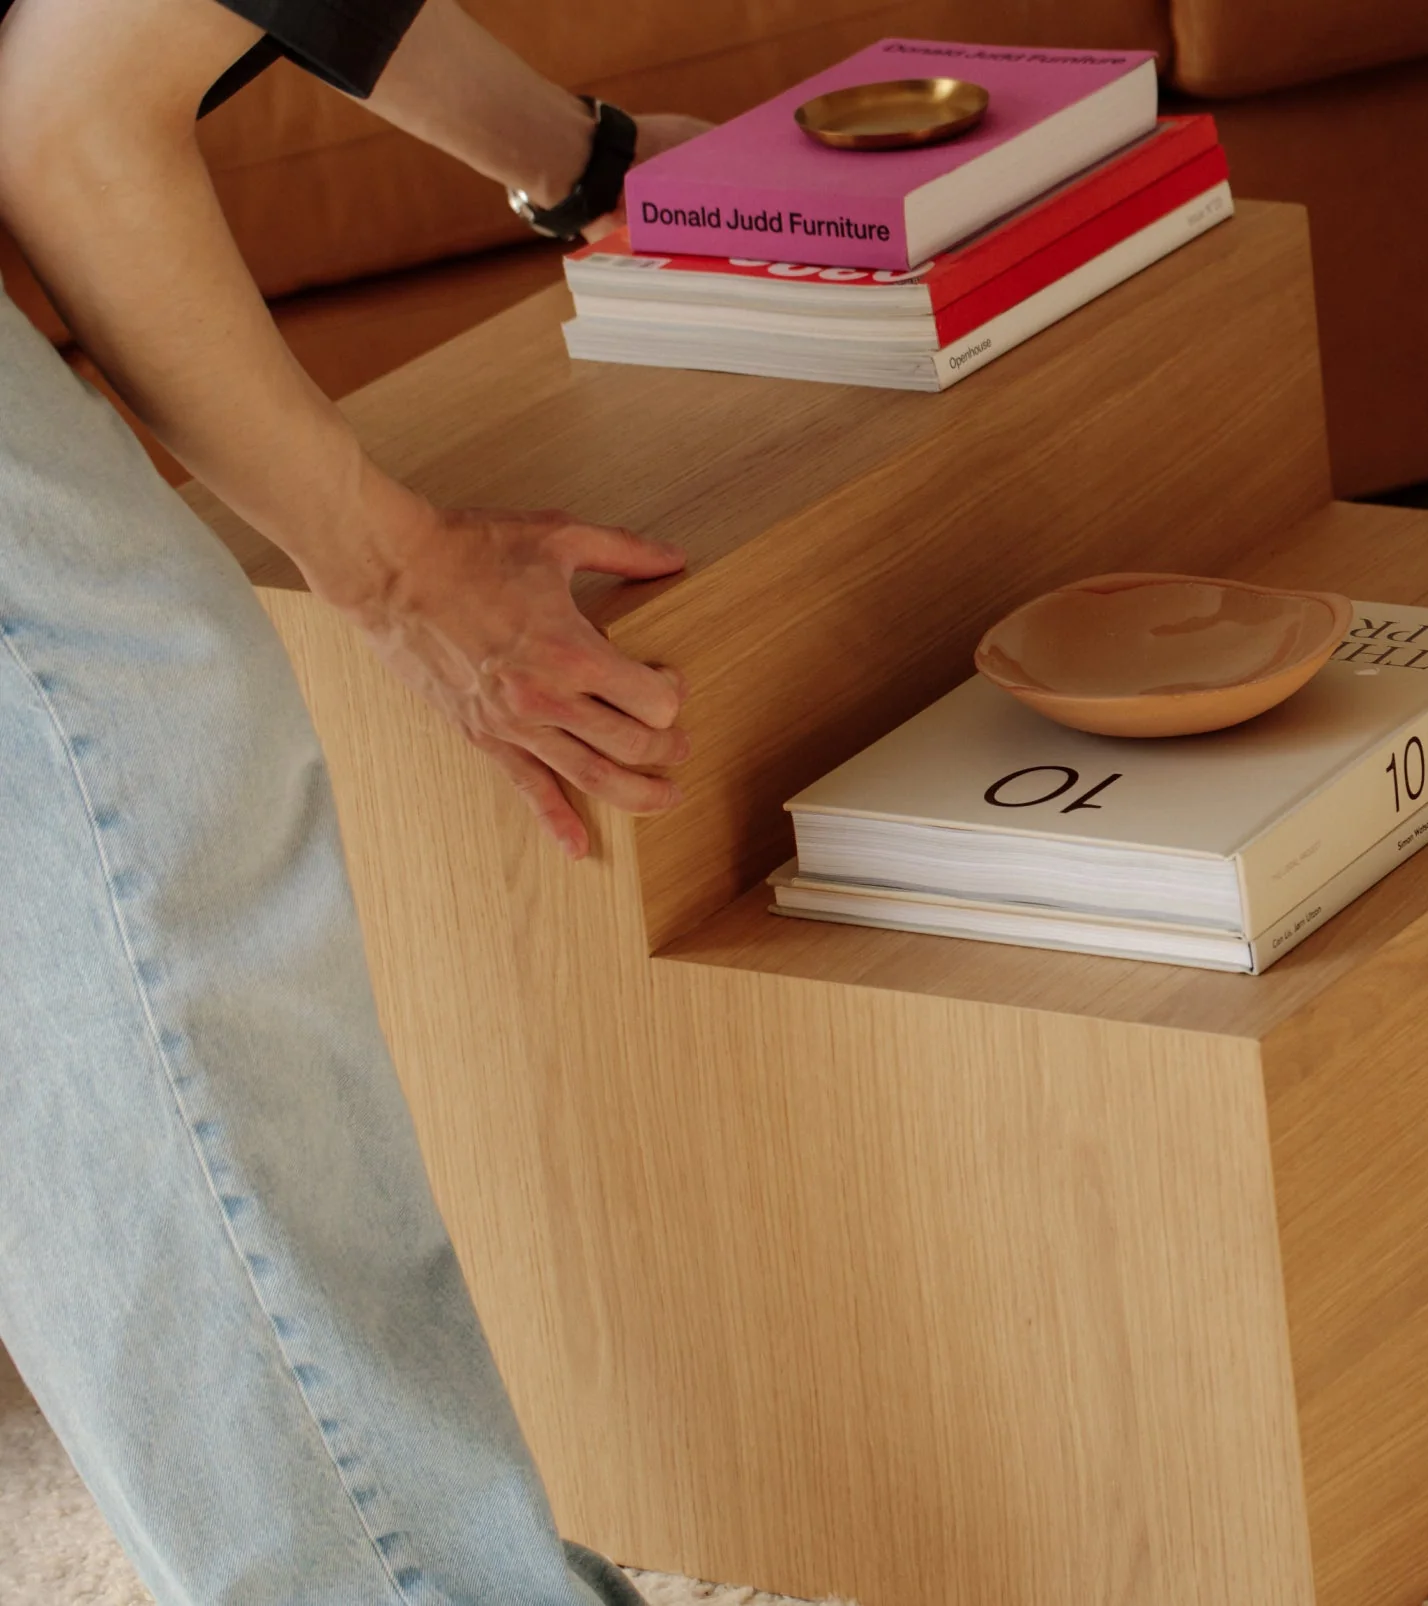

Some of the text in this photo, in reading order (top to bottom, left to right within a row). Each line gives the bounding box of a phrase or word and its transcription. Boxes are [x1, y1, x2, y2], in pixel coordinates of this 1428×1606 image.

[641, 201, 891, 242] Donald Judd Furniture
[949, 338, 992, 369] Openhouse
[983, 765, 1124, 814] 10
[1385, 735, 1425, 813] 10
